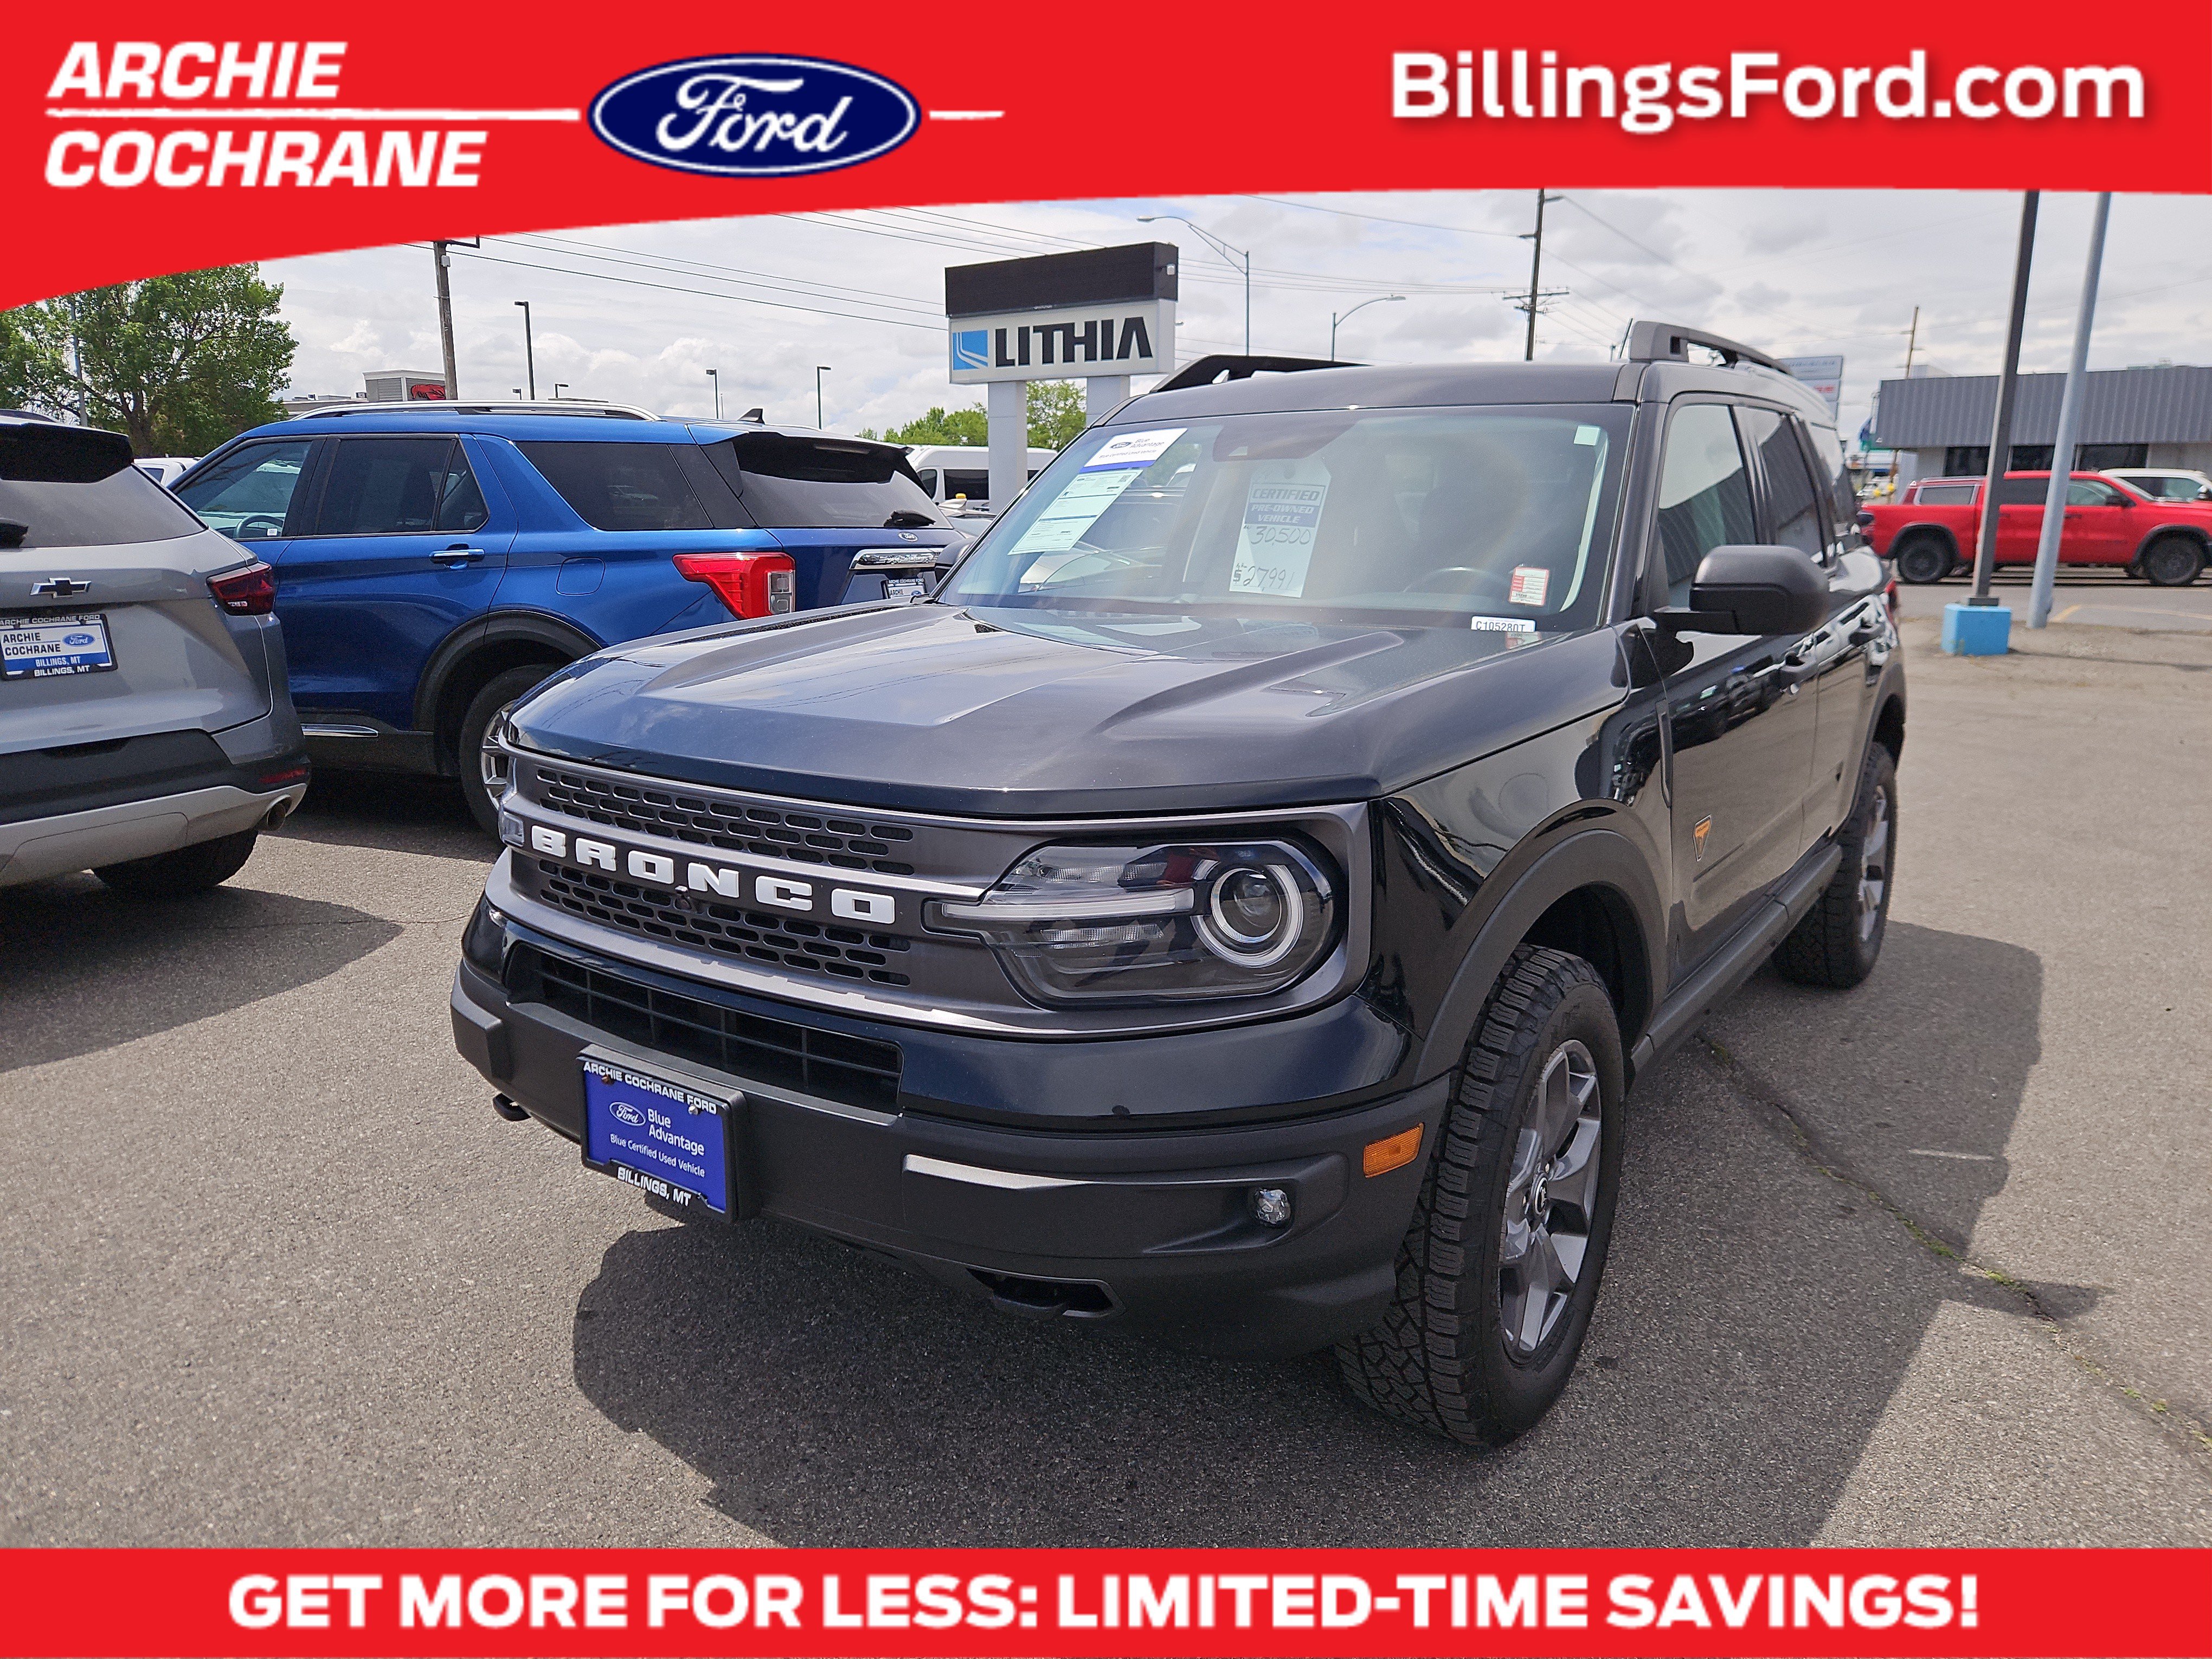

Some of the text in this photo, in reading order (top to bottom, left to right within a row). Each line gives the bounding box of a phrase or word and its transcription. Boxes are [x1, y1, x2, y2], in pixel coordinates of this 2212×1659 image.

[995, 316, 1154, 368] LITHIA
[1252, 488, 1320, 501] CERTIFIED
[1251, 504, 1314, 515] PRE-OWNED
[1257, 515, 1301, 524] VEHICLE
[31, 615, 76, 623] COCHRANE
[3, 632, 41, 644] ARCHIE
[69, 635, 88, 645] Ford
[5, 644, 61, 656] COCHRANE
[35, 656, 81, 667] BILLINGS, MT
[34, 665, 90, 677] BILLINGS, MT
[531, 825, 895, 924] BRONCO
[583, 1061, 717, 1115] ARCHIE COCHRANE FORD
[616, 1104, 639, 1123] Ford
[647, 1108, 671, 1129] Blue
[648, 1124, 705, 1156] Advantage
[610, 1133, 705, 1178] Blue Certified Used Vehicle
[617, 1166, 692, 1207] BILLINGS, MT
